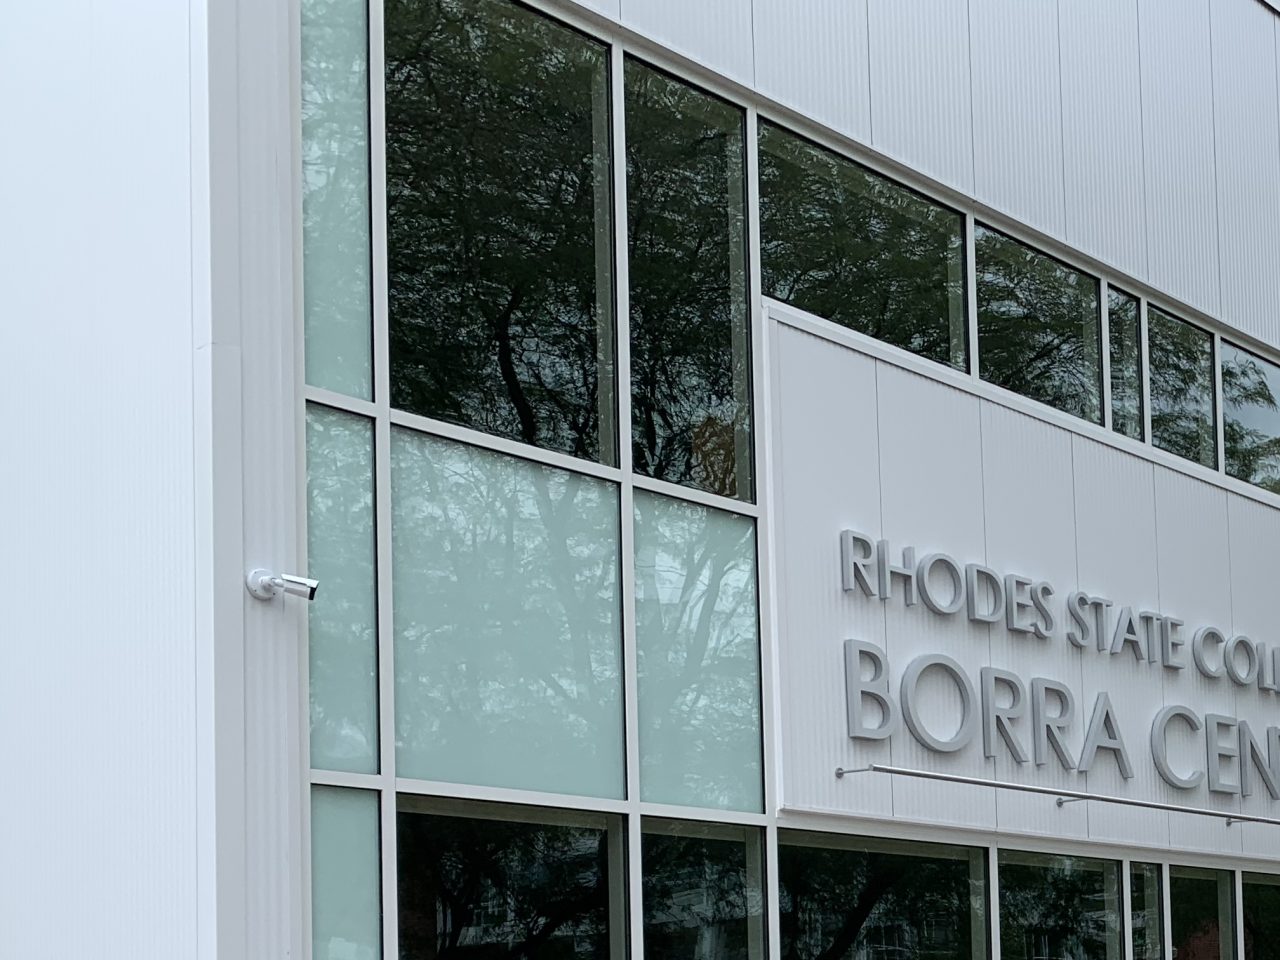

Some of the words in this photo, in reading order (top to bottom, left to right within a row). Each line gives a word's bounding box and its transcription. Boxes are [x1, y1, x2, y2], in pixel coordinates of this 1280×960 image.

[840, 529, 1056, 640] RHODES
[1066, 590, 1186, 671] STATE
[843, 638, 1135, 780] BORRA
